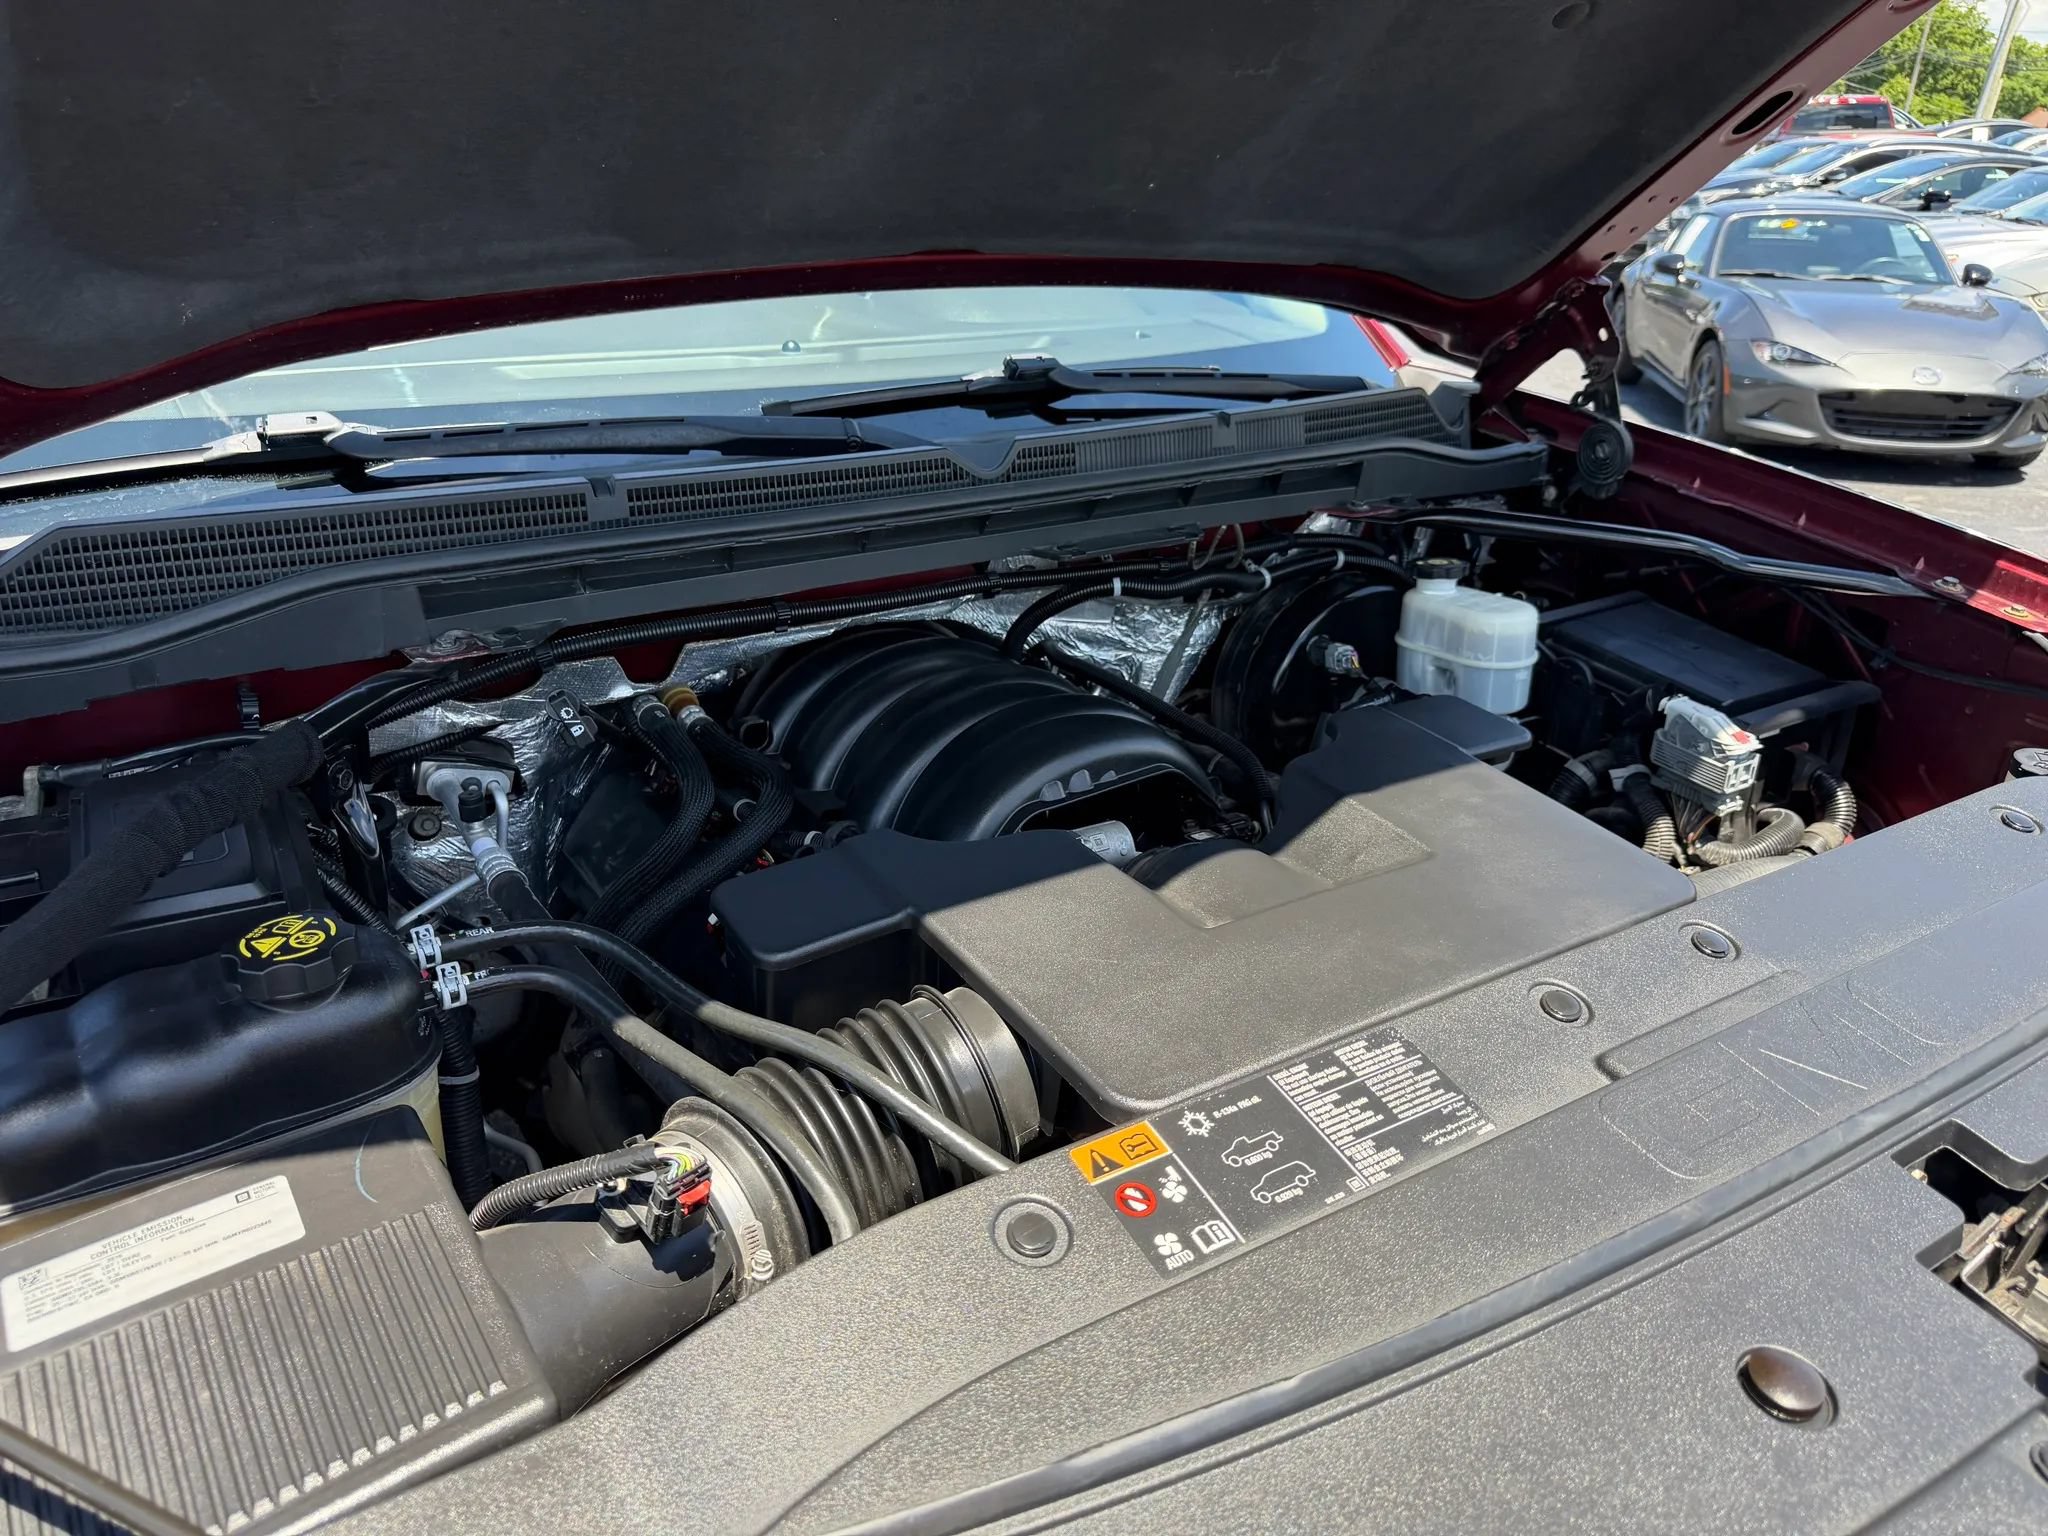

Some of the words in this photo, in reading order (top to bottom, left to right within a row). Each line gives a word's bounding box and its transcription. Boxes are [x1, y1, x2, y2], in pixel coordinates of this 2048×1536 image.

[465, 926, 495, 937] REAR
[90, 1242, 132, 1260] CONTROL
[134, 1216, 196, 1243] INFORMATION
[101, 1231, 139, 1250] VEHICLE
[140, 1215, 183, 1235] EMISSION
[1165, 1249, 1195, 1270] AUTO
